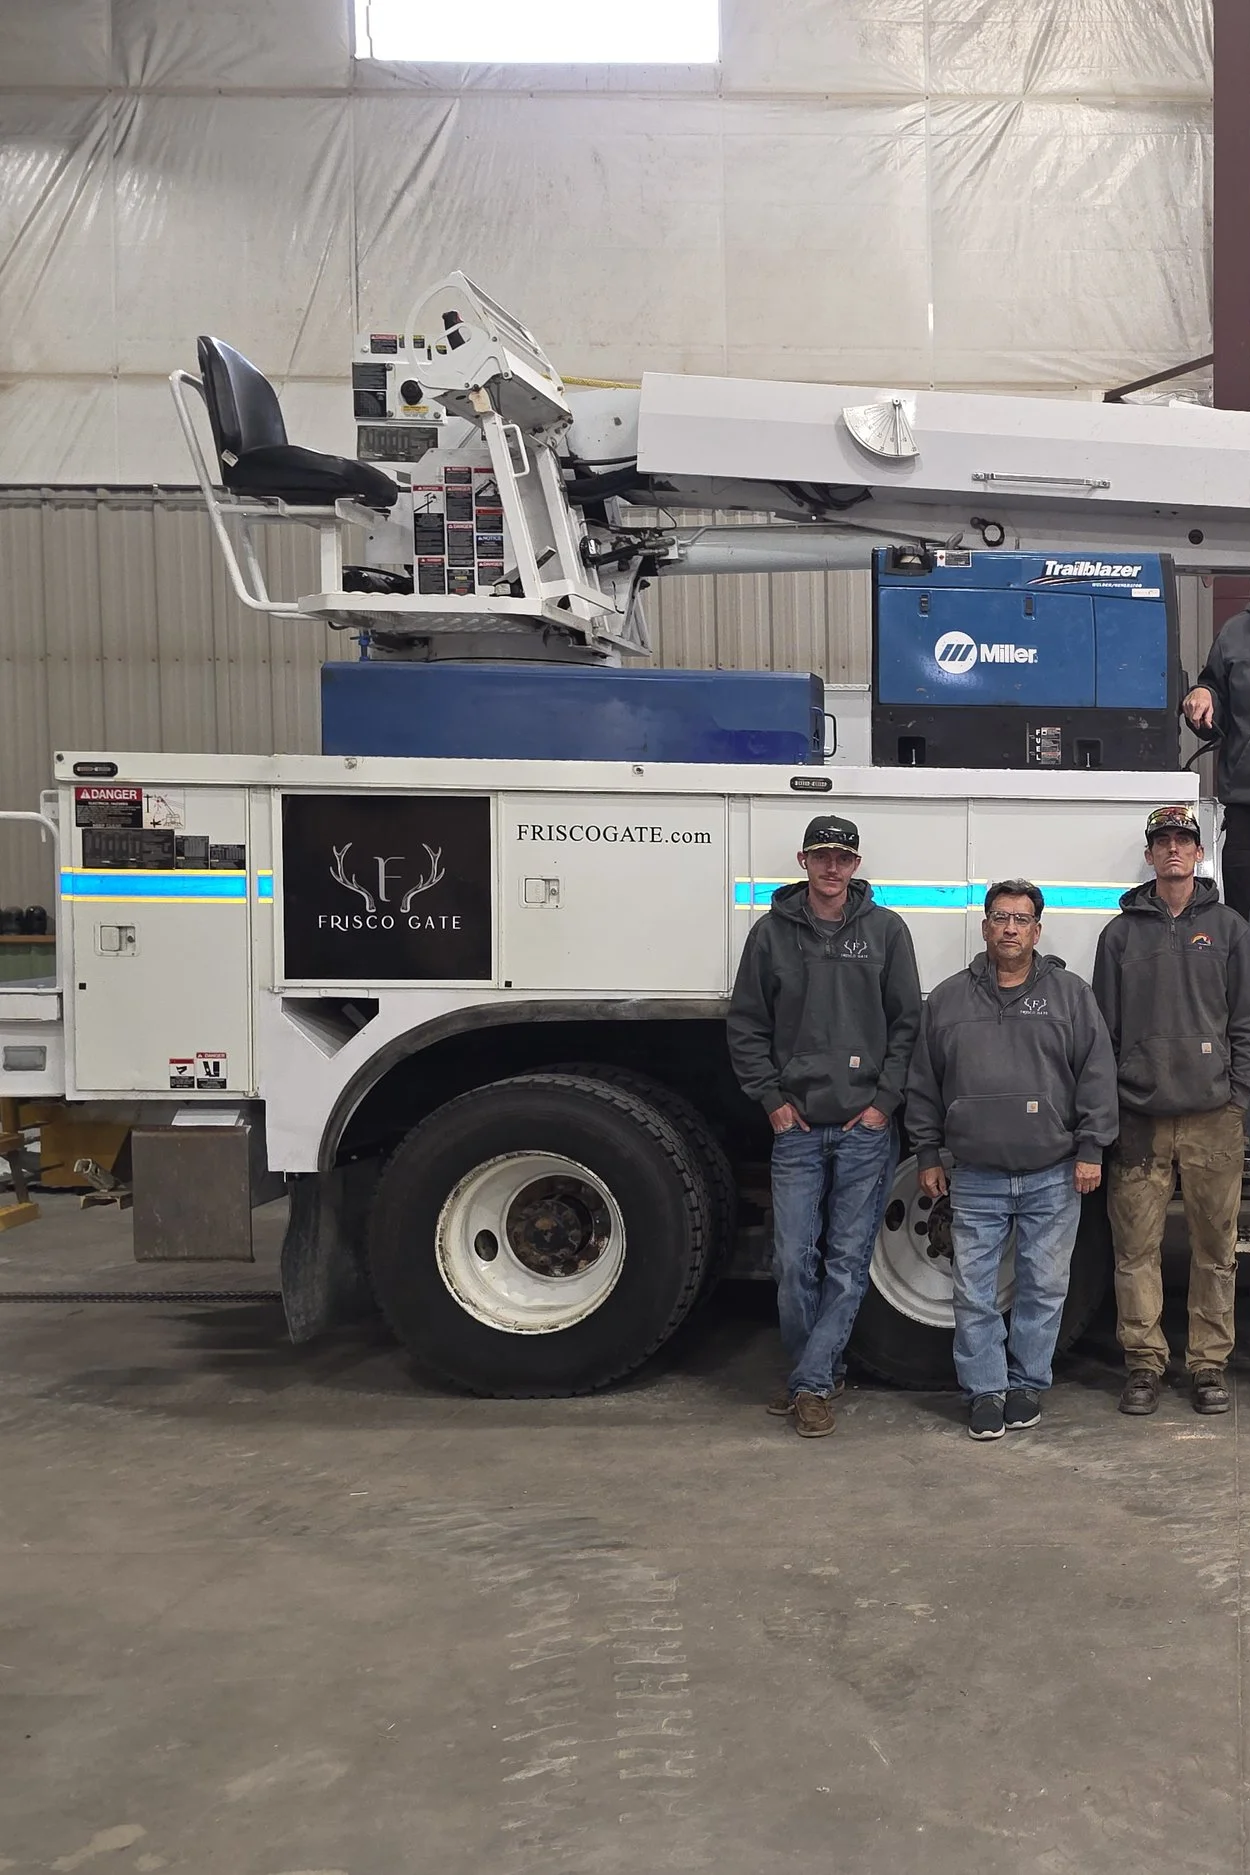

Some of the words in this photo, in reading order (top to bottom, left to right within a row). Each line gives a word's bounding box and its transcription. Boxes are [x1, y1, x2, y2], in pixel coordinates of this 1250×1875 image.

[1045, 560, 1142, 578] Trailblazer
[91, 789, 137, 800] DANGER
[516, 824, 712, 844] FRISCOGATE.com
[373, 856, 406, 902] F
[318, 914, 395, 932] FRISCO
[408, 916, 461, 930] GATE
